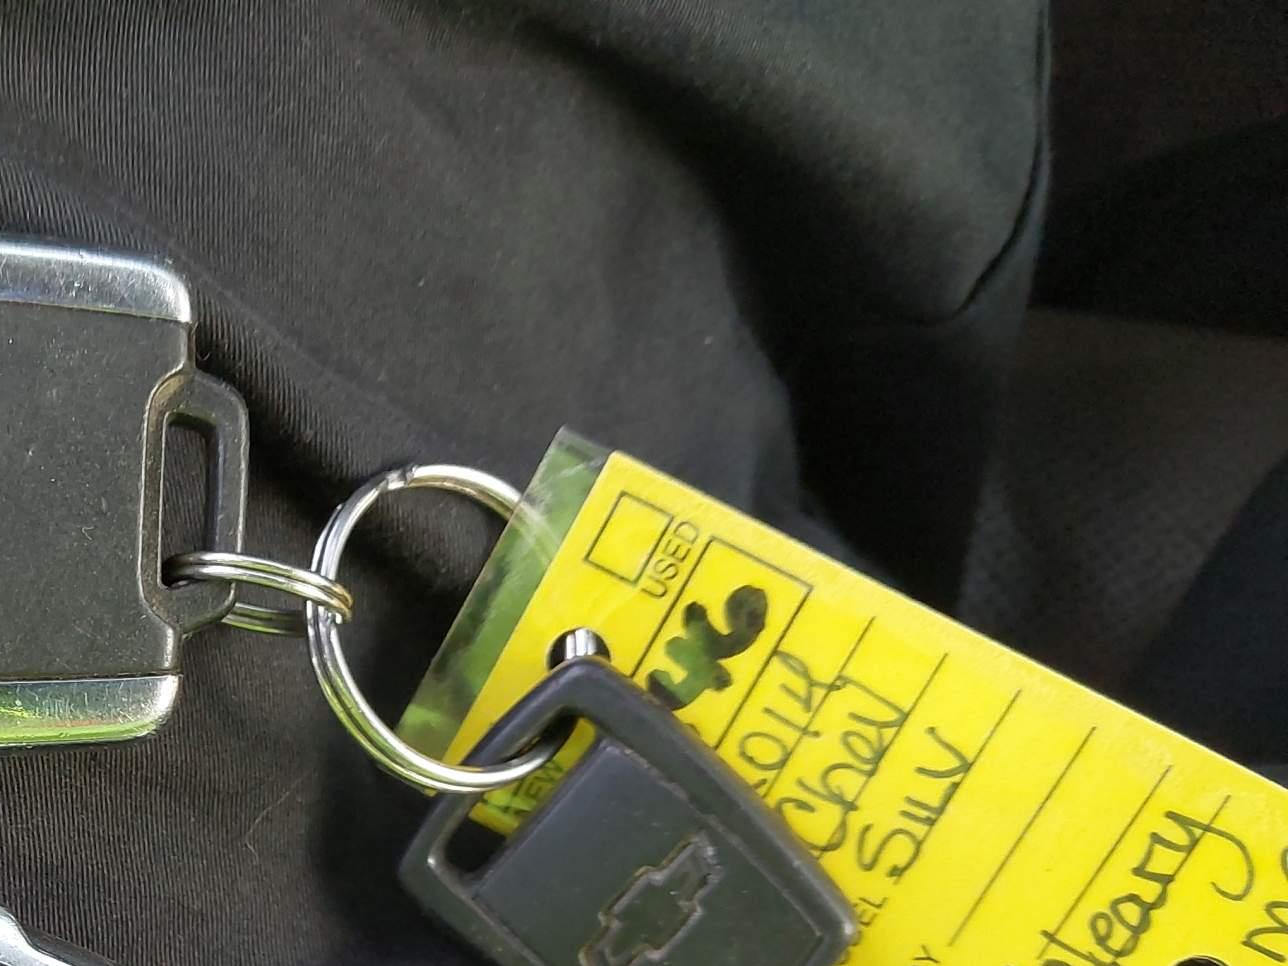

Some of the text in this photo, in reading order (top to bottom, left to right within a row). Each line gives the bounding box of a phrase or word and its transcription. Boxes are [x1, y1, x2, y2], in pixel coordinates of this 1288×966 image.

[640, 520, 700, 600] USED
[645, 583, 768, 738] 46
[738, 650, 843, 789] 014
